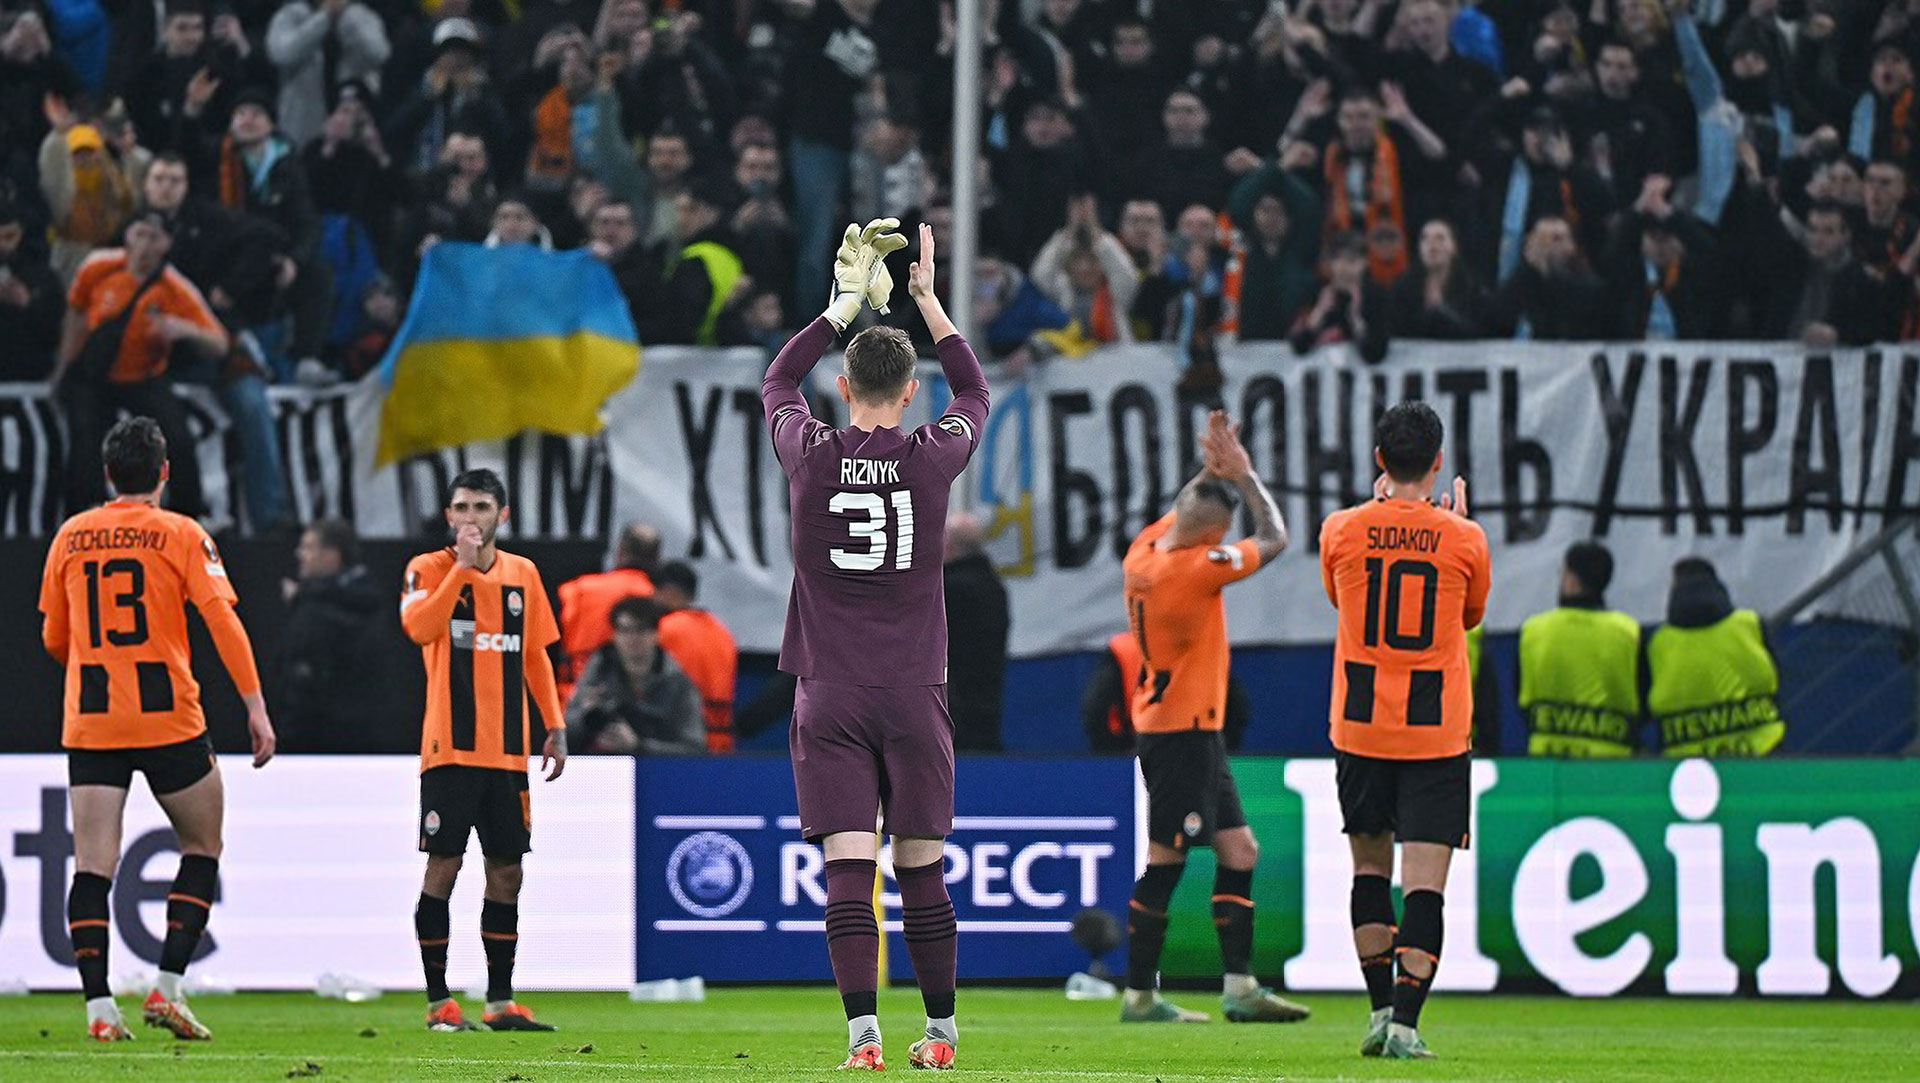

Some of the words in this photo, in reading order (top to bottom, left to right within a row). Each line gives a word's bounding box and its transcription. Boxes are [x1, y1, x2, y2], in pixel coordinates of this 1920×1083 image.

[841, 458, 900, 485] RIZNYK
[829, 489, 914, 571] 31
[1367, 526, 1441, 553] SUDAKOV
[83, 558, 148, 648] 13
[1364, 557, 1438, 651] 10
[475, 633, 521, 652] SCM
[1535, 703, 1629, 739] EWARD
[0, 787, 222, 968] te
[780, 841, 1115, 907] RECT
[1283, 758, 1920, 998] Hein
